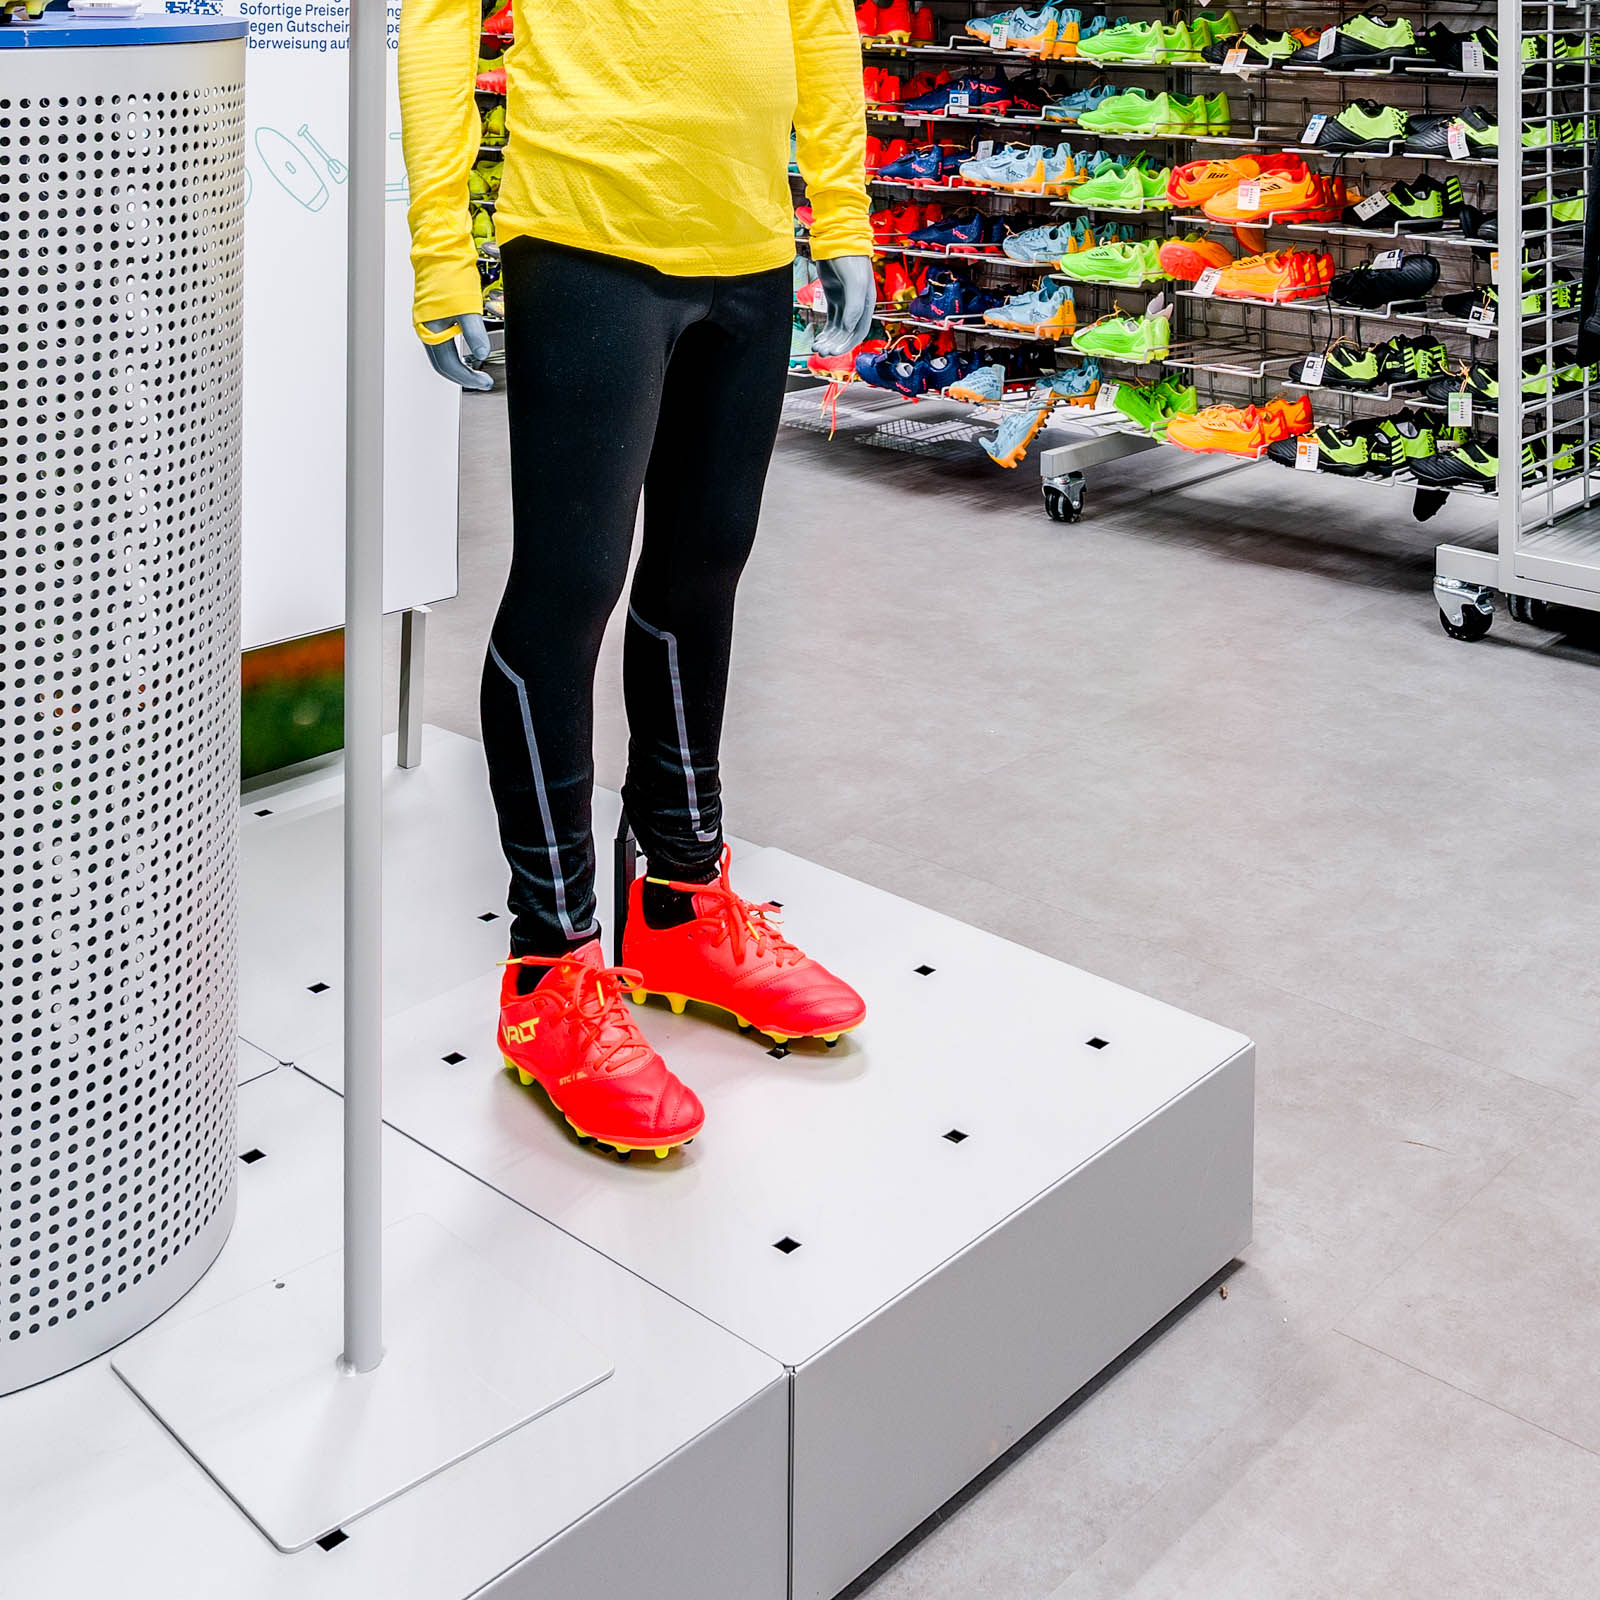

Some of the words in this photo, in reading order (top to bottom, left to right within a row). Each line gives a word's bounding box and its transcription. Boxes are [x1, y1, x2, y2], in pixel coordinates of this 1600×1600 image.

[239, 2, 301, 19] Sofortige
[249, 21, 283, 35] egen
[246, 37, 327, 52] berweisung
